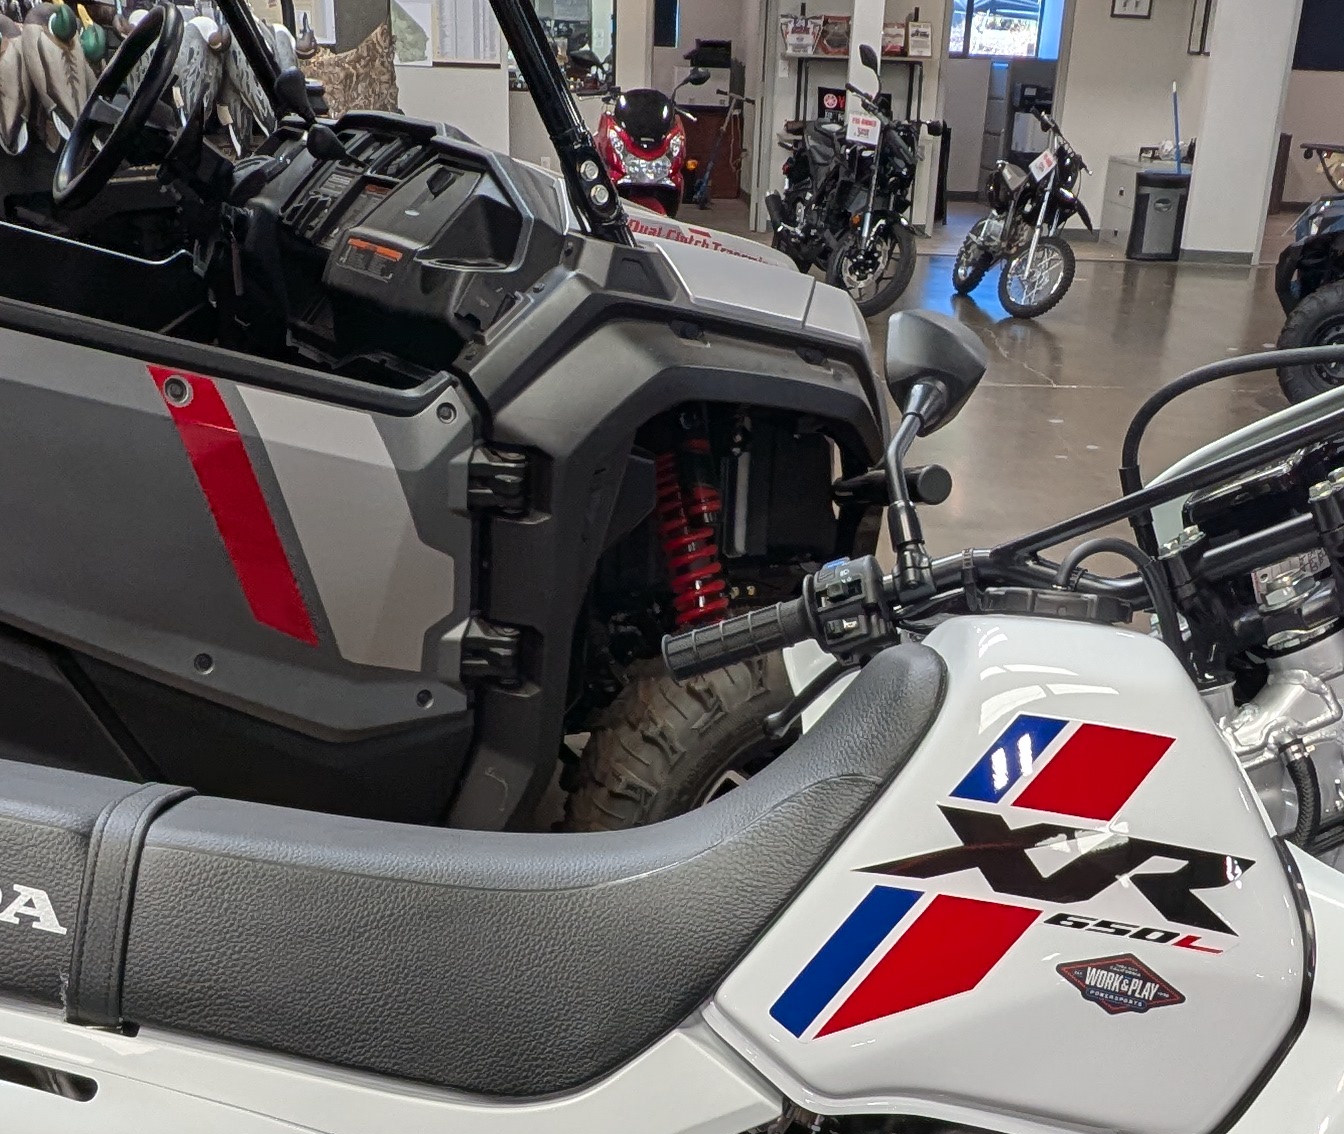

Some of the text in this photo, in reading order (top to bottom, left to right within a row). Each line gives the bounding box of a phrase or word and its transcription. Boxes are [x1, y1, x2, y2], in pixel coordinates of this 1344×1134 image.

[851, 803, 1256, 936] XR
[1043, 911, 1224, 954] 650L
[1088, 990, 1143, 1006] POWERSPORTS
